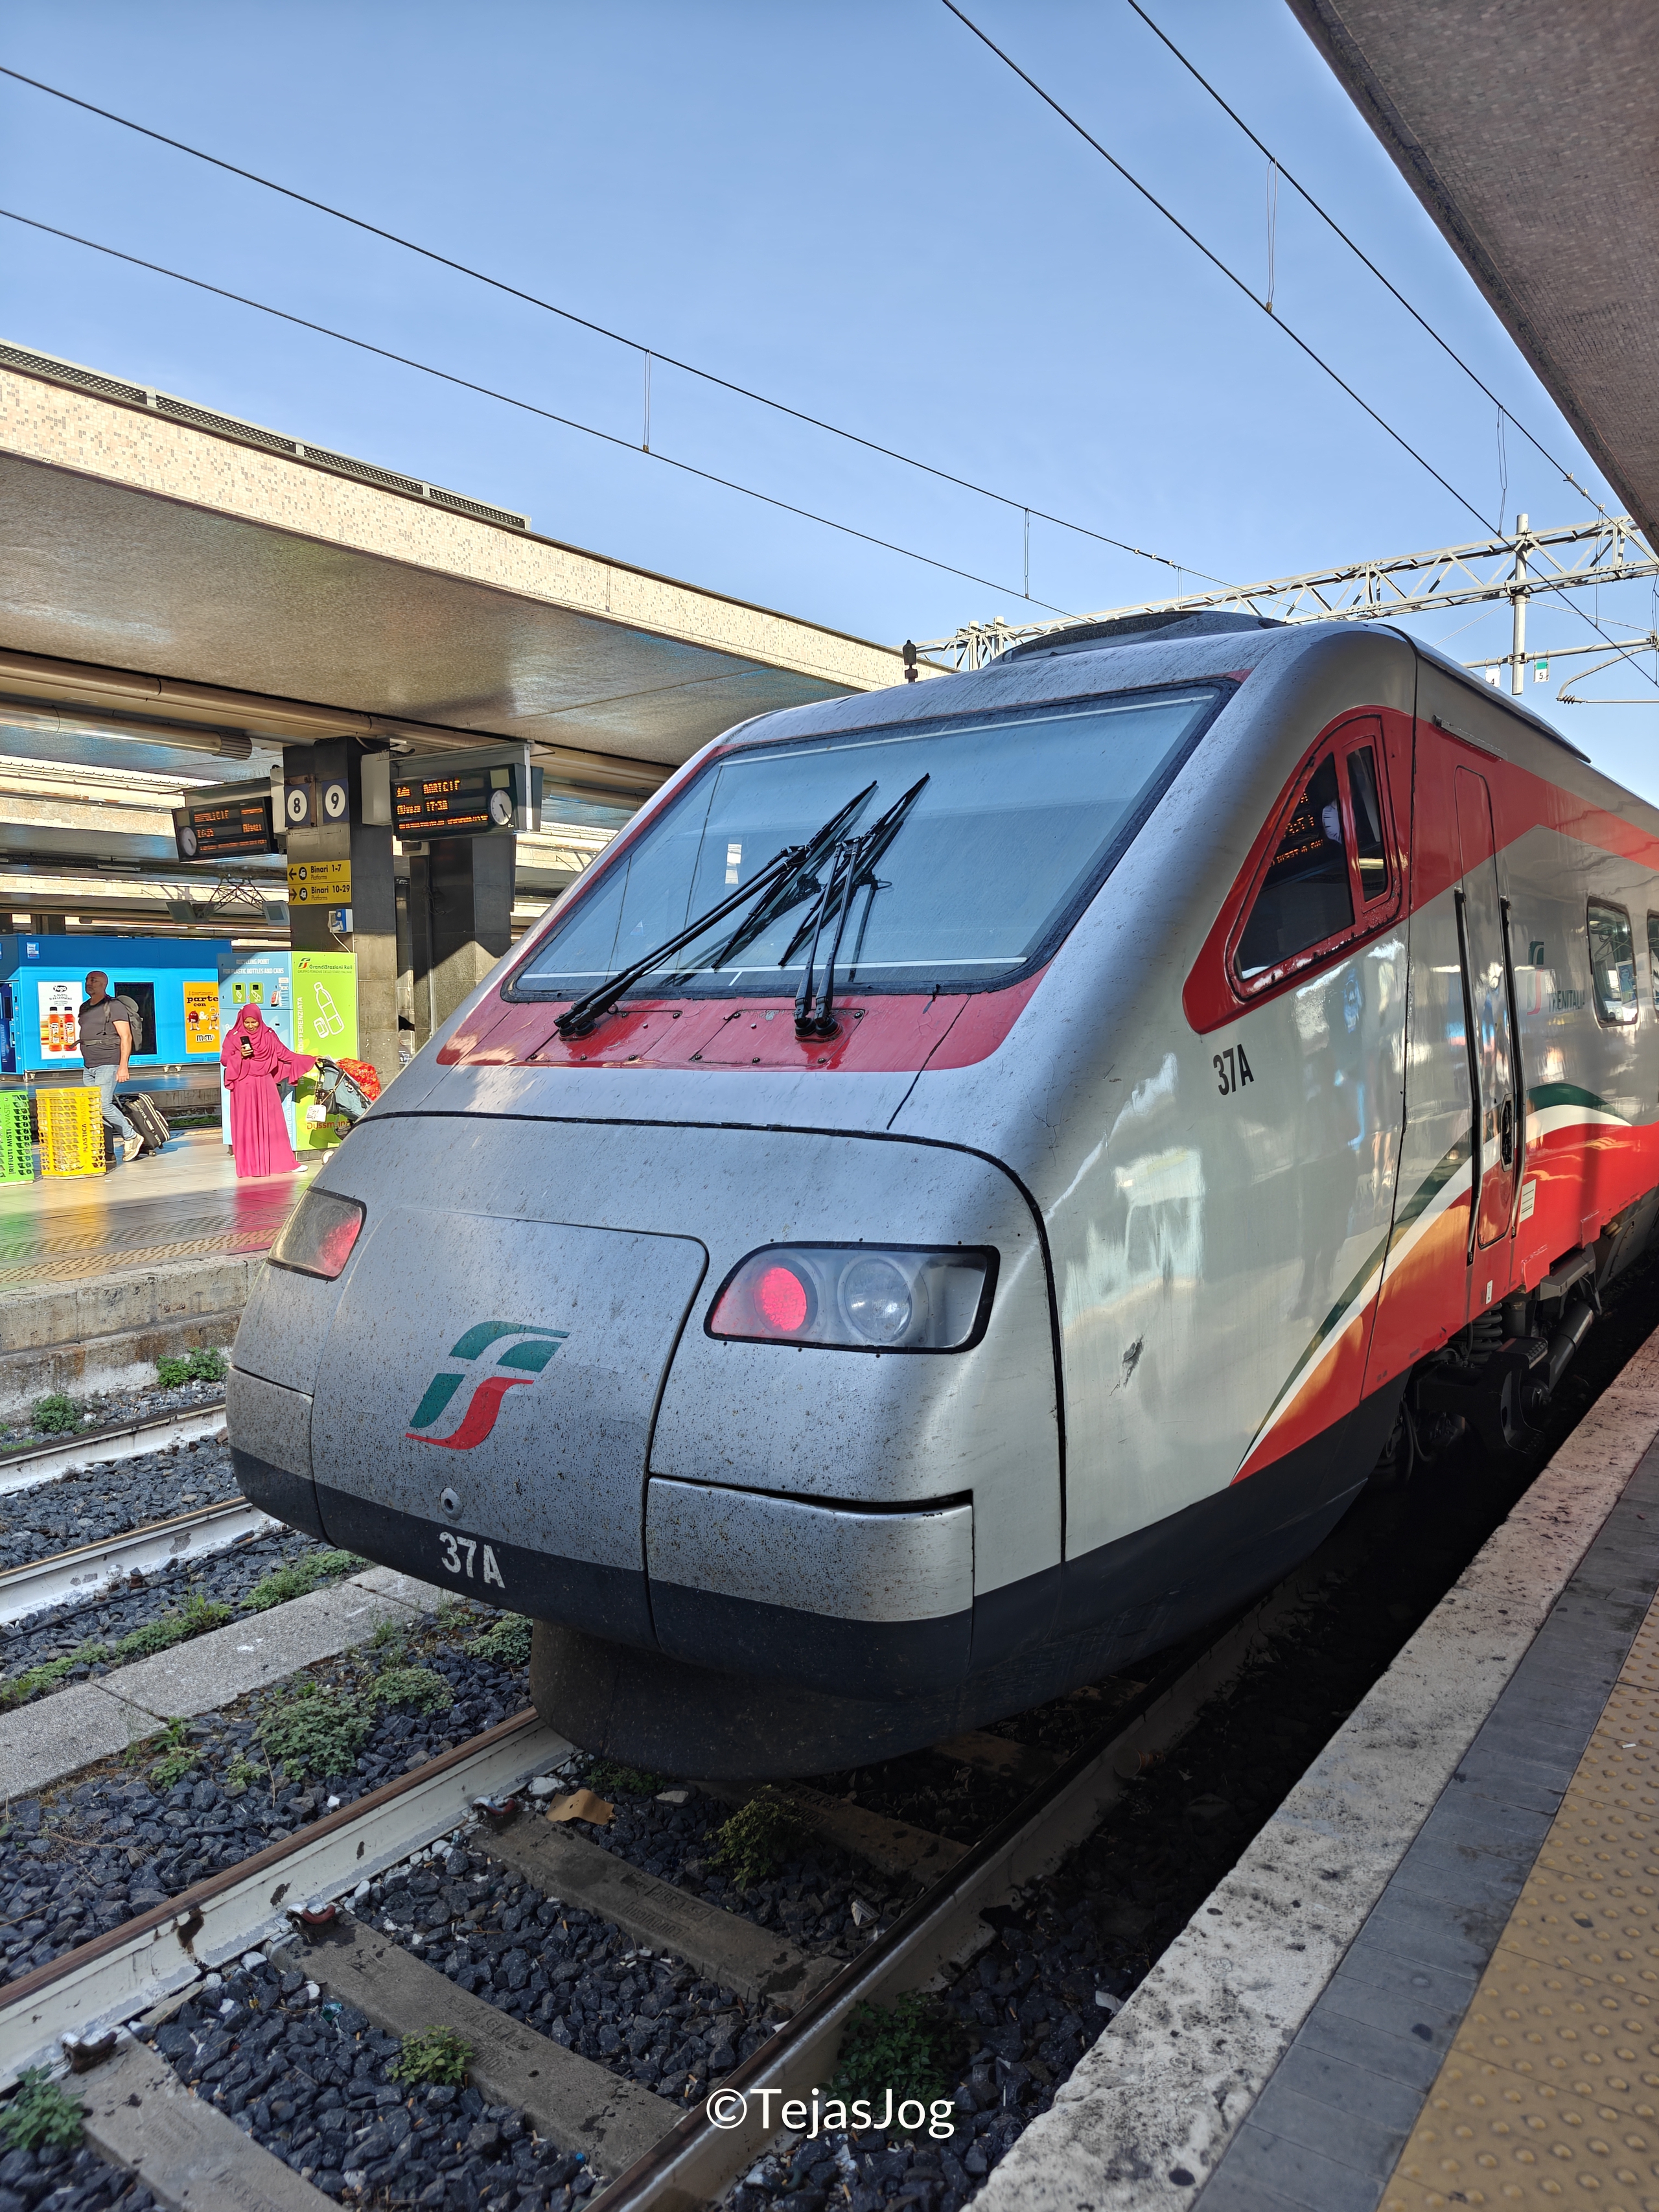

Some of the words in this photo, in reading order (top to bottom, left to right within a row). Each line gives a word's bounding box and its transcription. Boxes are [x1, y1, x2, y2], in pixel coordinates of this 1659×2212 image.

[293, 797, 301, 814] 8
[331, 792, 339, 809] 9
[310, 865, 329, 873] Binari
[1213, 1043, 1255, 1096] 37A
[439, 1531, 505, 1589] 37A
